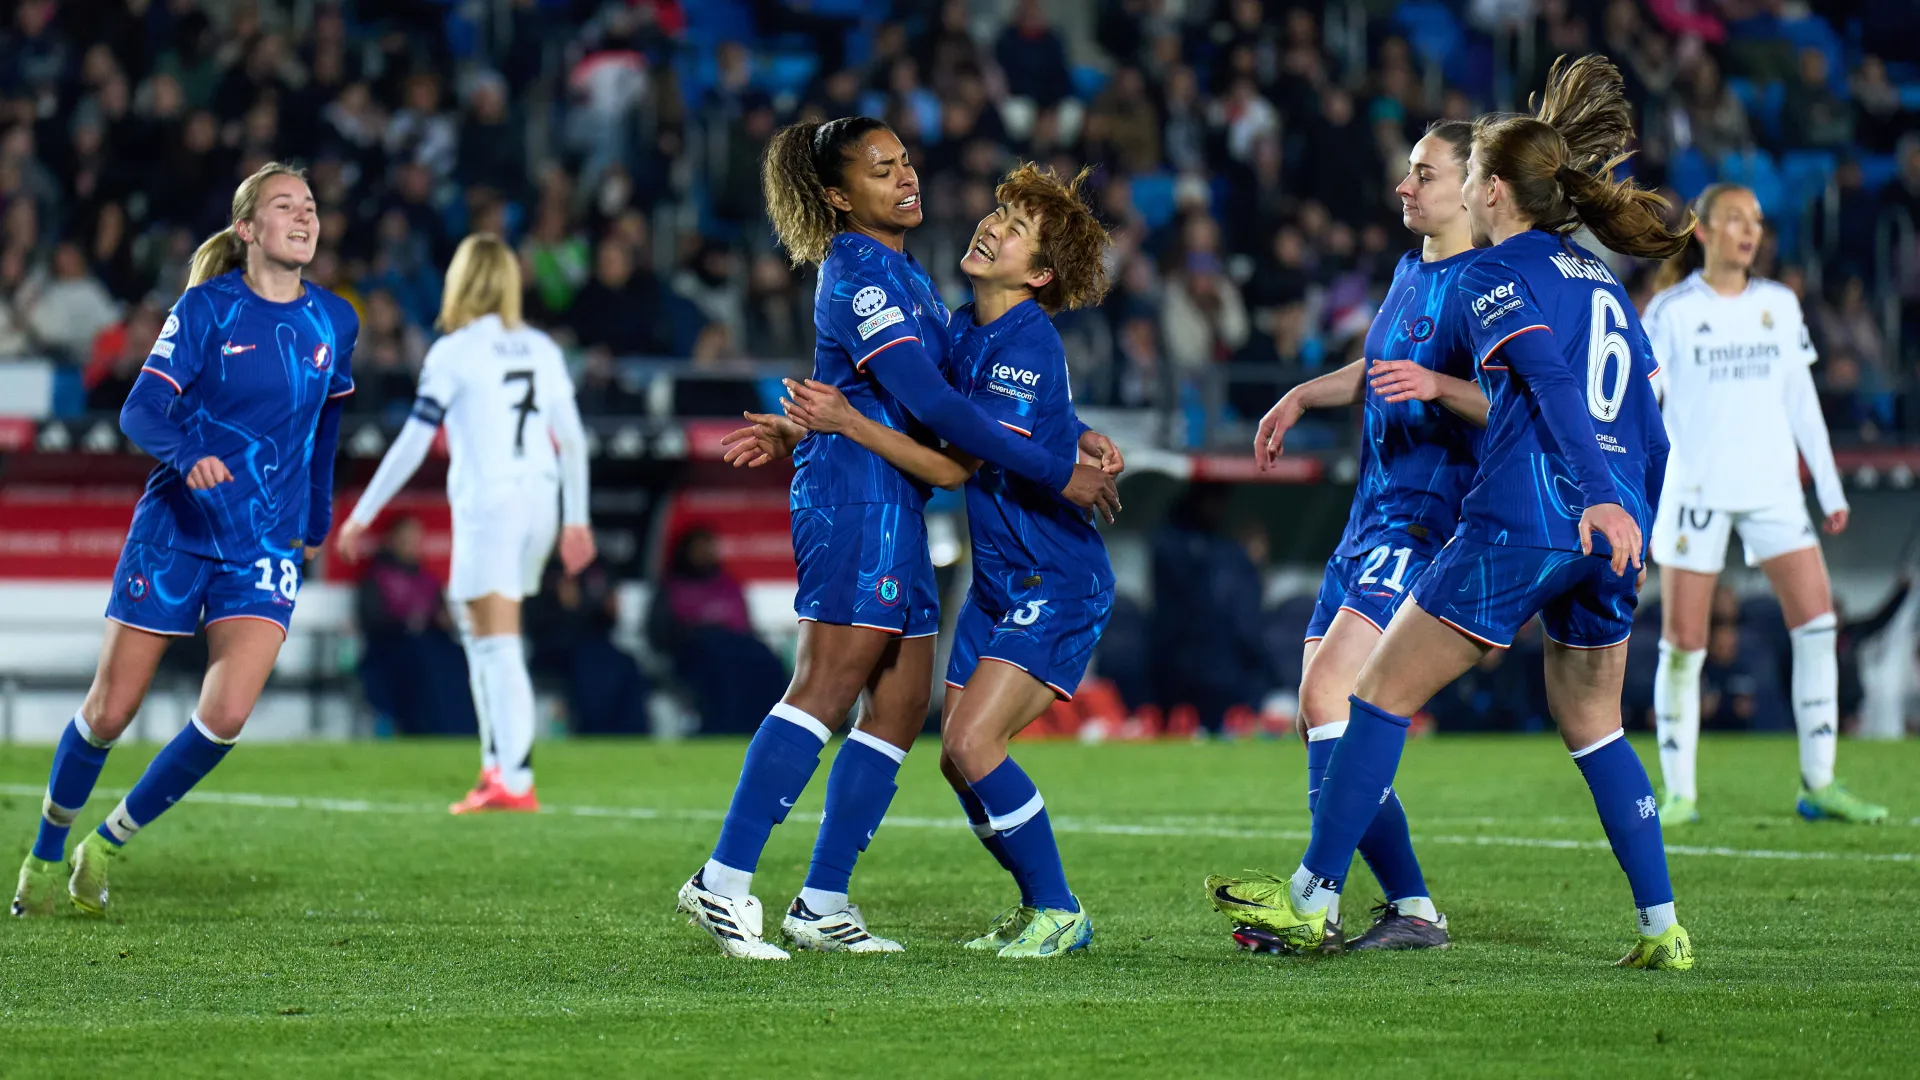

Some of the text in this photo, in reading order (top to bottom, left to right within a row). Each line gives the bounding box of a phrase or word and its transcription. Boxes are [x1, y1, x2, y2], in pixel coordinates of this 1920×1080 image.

[1471, 281, 1515, 317] fever
[860, 310, 902, 334] FOUNDATION
[1586, 287, 1632, 423] 6
[1693, 341, 1780, 366] Emirates
[988, 381, 1034, 401] feverup.com
[991, 362, 1041, 387] fever
[502, 369, 540, 459] 7
[254, 557, 298, 601] 18
[1358, 545, 1413, 594] 21
